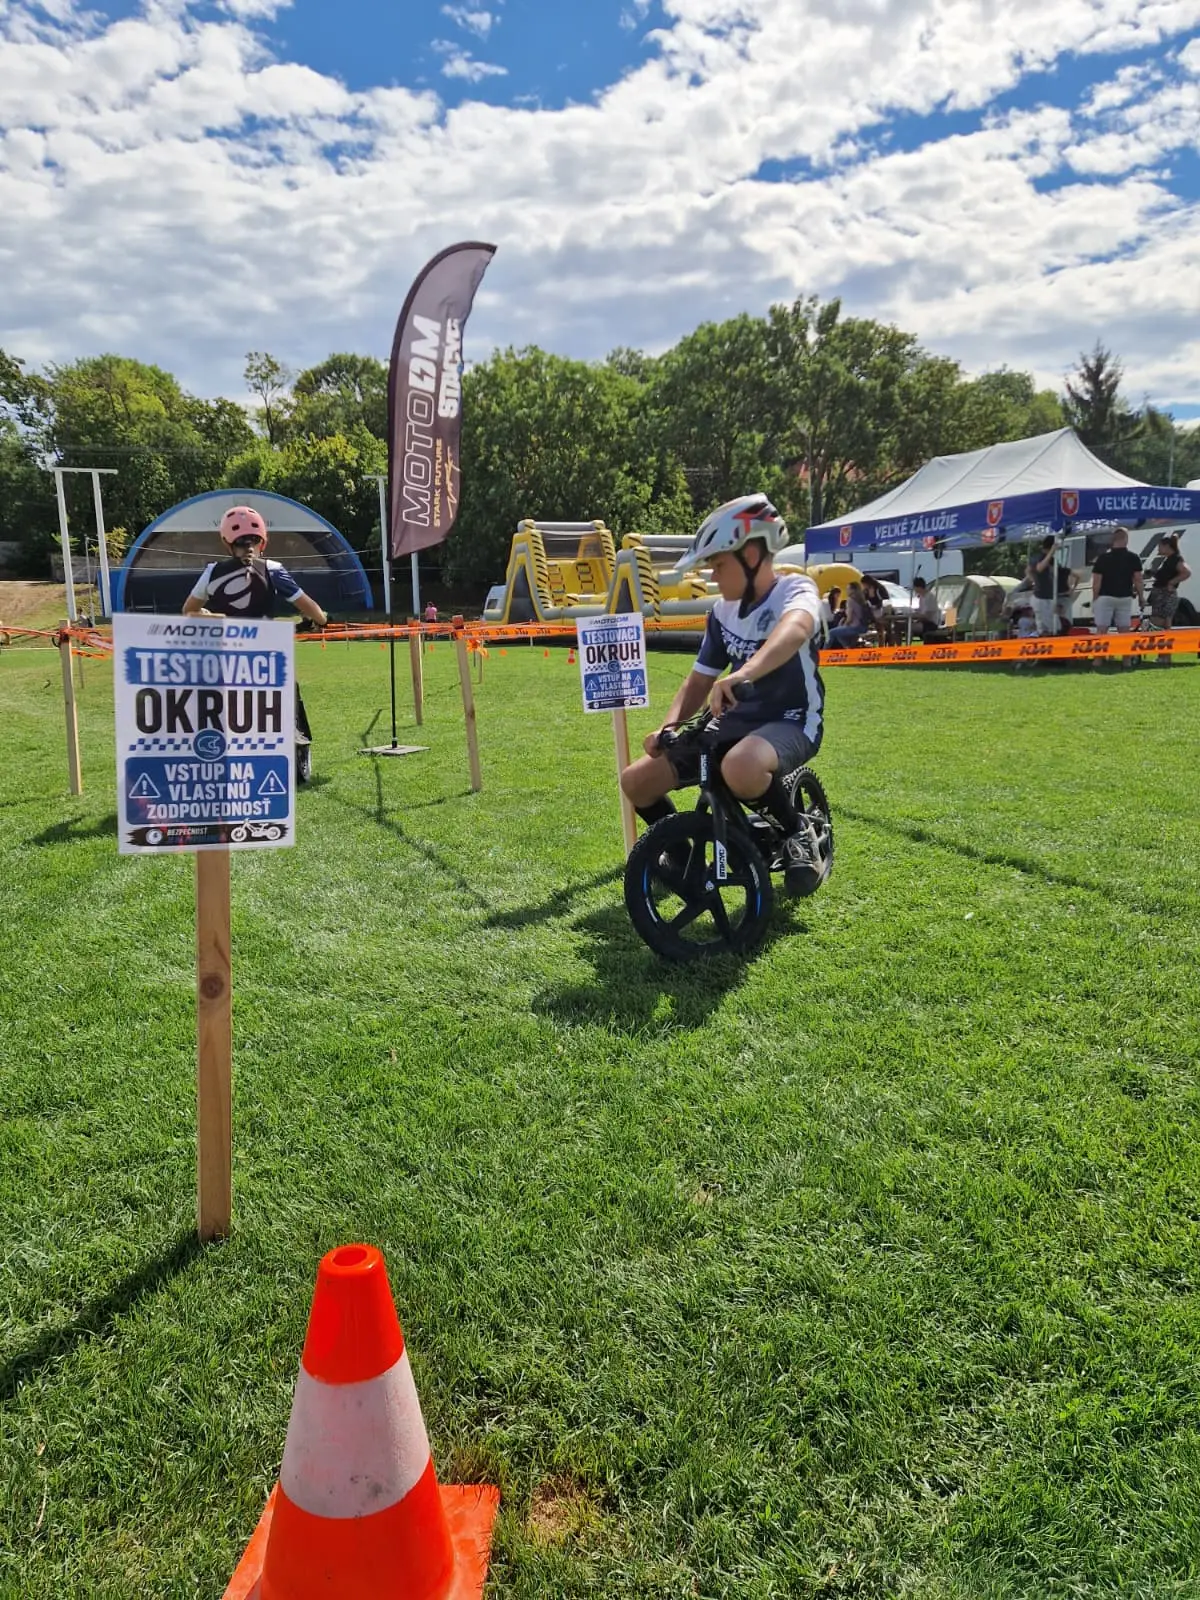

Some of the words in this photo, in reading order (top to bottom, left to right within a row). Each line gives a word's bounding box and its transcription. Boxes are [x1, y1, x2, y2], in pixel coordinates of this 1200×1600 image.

[434, 438, 442, 485] FUTURE
[433, 487, 442, 527] STARK
[1140, 492, 1192, 511] ZÁLUŽIE
[909, 511, 959, 535] ZÁLUŽIE
[162, 624, 258, 639] MOTODM
[586, 642, 640, 664] OKRUH
[930, 647, 958, 660] KTM
[971, 645, 1002, 659] KTM
[1019, 641, 1053, 656] KTM
[1072, 638, 1110, 654] KTM
[1131, 634, 1175, 651] KTM
[135, 651, 276, 685] TESTOVACÍ
[135, 687, 282, 734] OKRUH
[164, 763, 224, 782] VSTUP
[229, 762, 255, 780] NA
[169, 779, 250, 801] VLASTNÚ
[146, 798, 271, 820] ZODPOVEDNOSŤ
